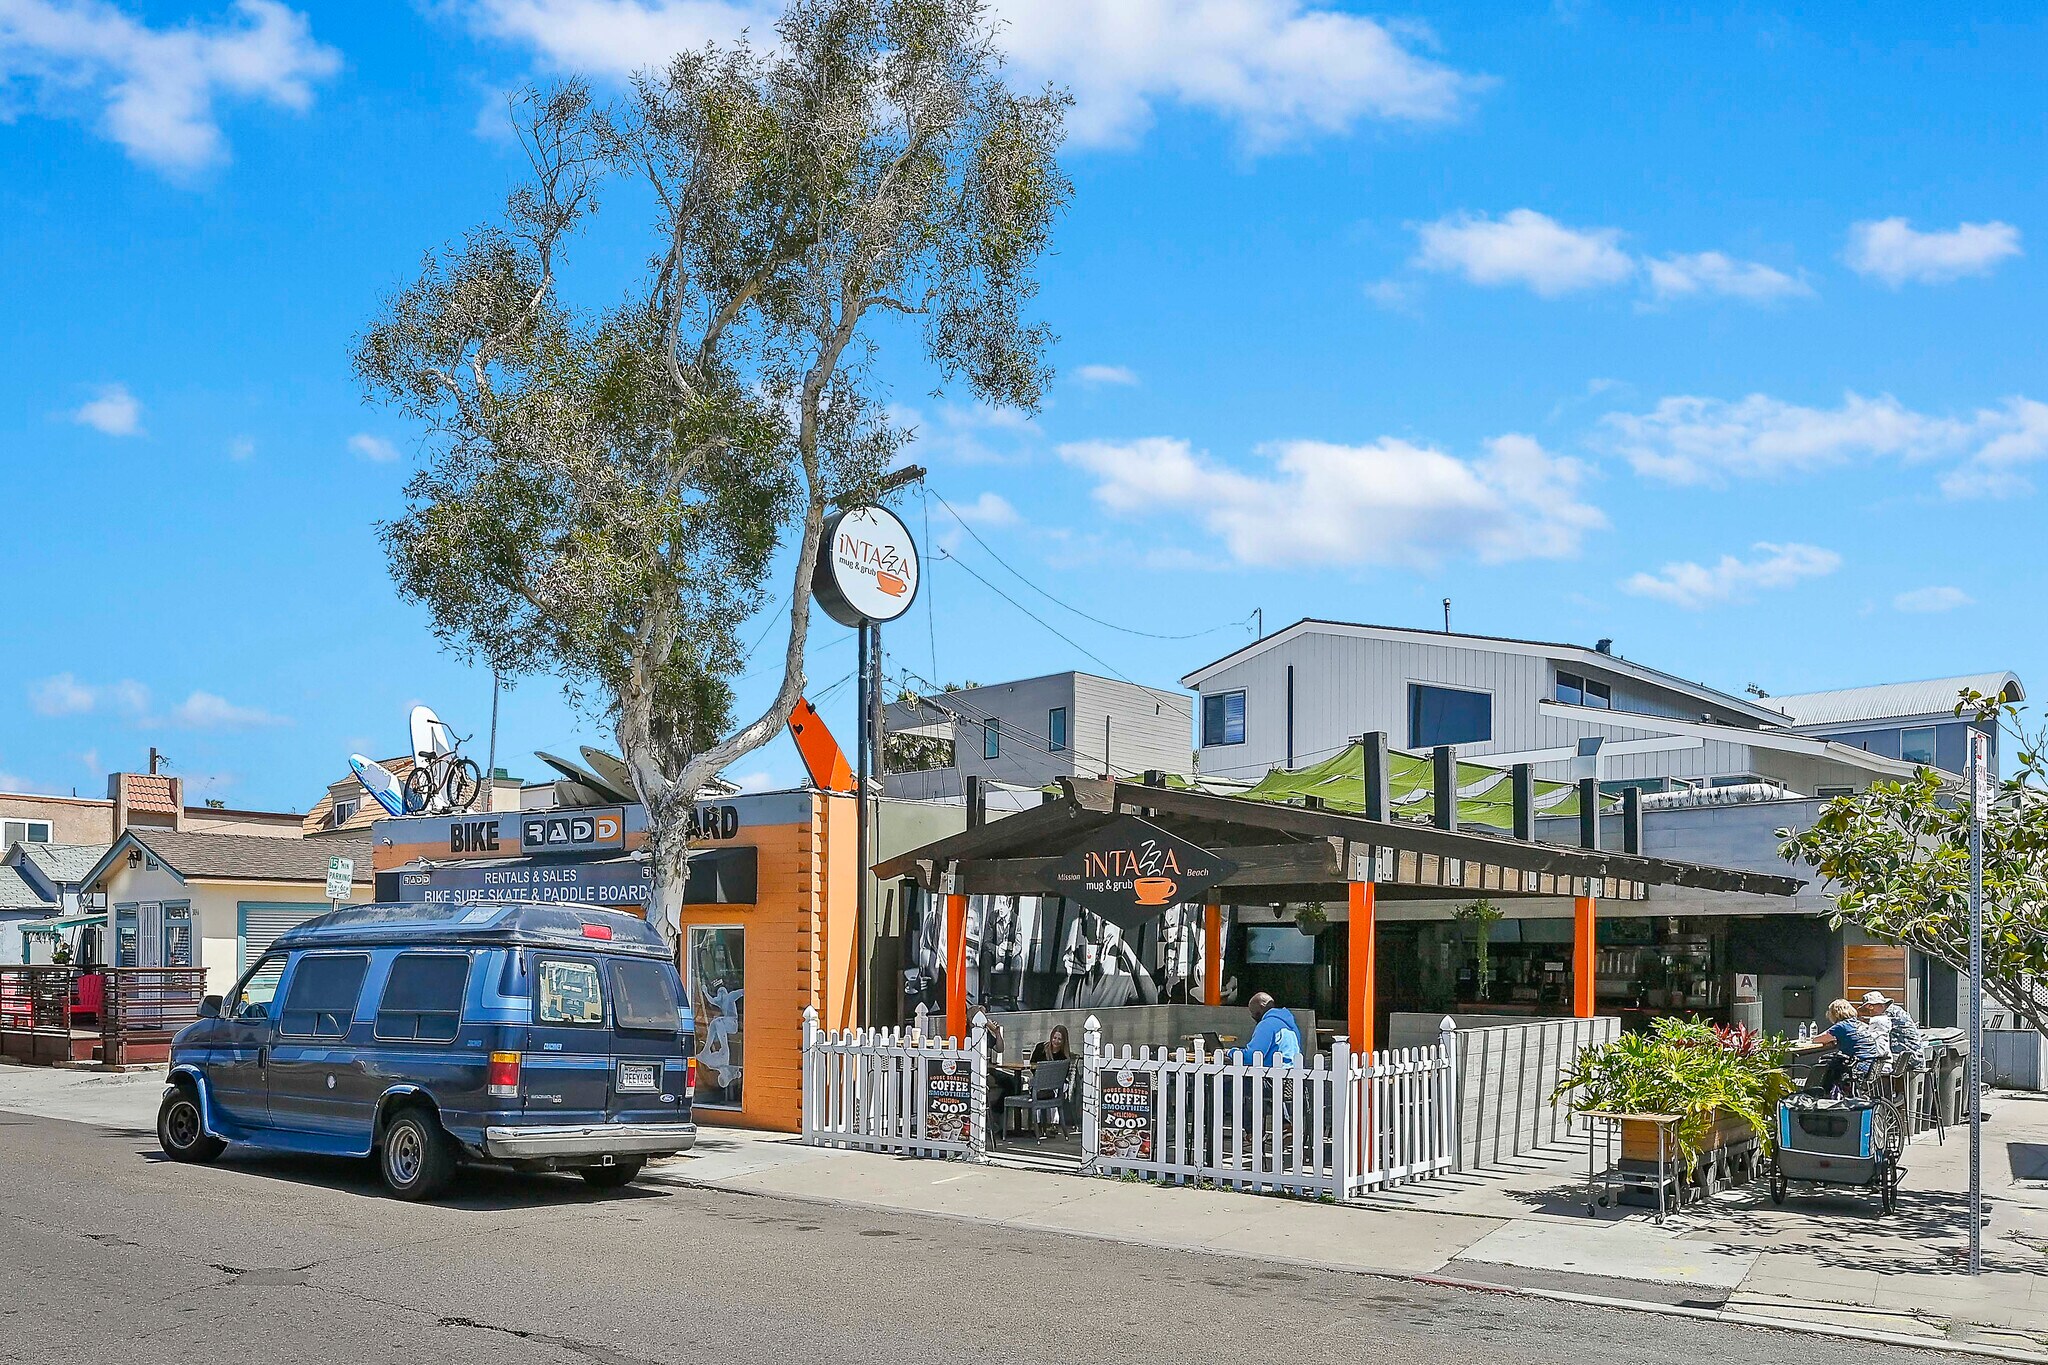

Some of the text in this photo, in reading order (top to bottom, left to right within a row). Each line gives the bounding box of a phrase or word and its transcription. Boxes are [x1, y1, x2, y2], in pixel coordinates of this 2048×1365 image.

[839, 557, 854, 569] mug
[860, 565, 876, 577] grub
[686, 805, 739, 840] ARD
[450, 821, 500, 853] BIKE
[526, 818, 619, 843] RADD
[331, 858, 338, 869] 15
[328, 871, 351, 882] PARKING
[485, 869, 577, 884] RENTALS & SALES
[1057, 873, 1081, 881] Mission
[1187, 868, 1209, 877] Beach
[1086, 879, 1133, 892] mug & grub
[424, 890, 451, 902] BIKE
[454, 889, 485, 902] SURF
[488, 888, 528, 901] SKATE
[532, 888, 540, 900] &
[544, 886, 595, 901] PADDLE
[1741, 976, 1753, 988] A
[931, 1080, 968, 1091] COFFEE
[1104, 1093, 1148, 1105] COFFEE
[931, 1100, 967, 1113] FOOD
[1105, 1114, 1146, 1128] FOOD
